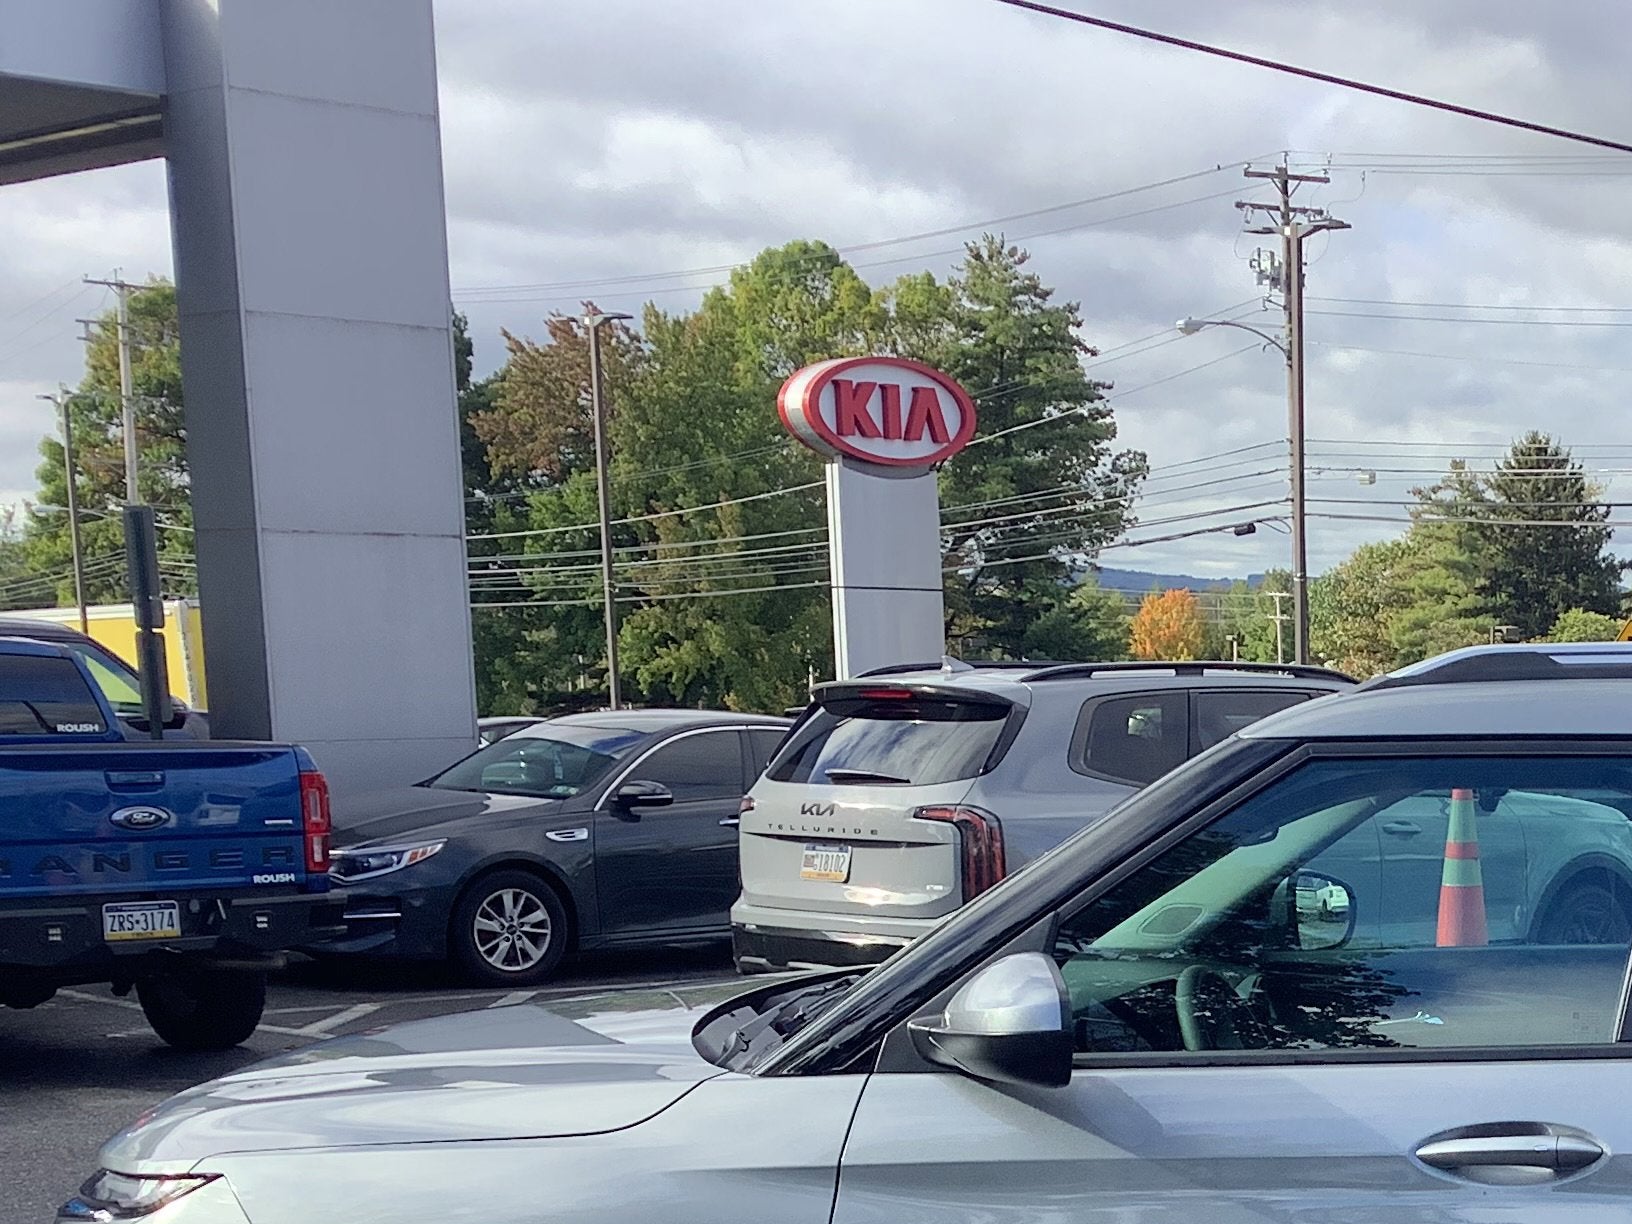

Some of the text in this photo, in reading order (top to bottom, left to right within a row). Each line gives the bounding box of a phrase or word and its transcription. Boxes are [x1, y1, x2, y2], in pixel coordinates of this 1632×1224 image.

[831, 379, 951, 443] KIA
[56, 724, 99, 733] ROUSH
[768, 823, 878, 835] TELLURIDE
[253, 873, 295, 884] ROUSH
